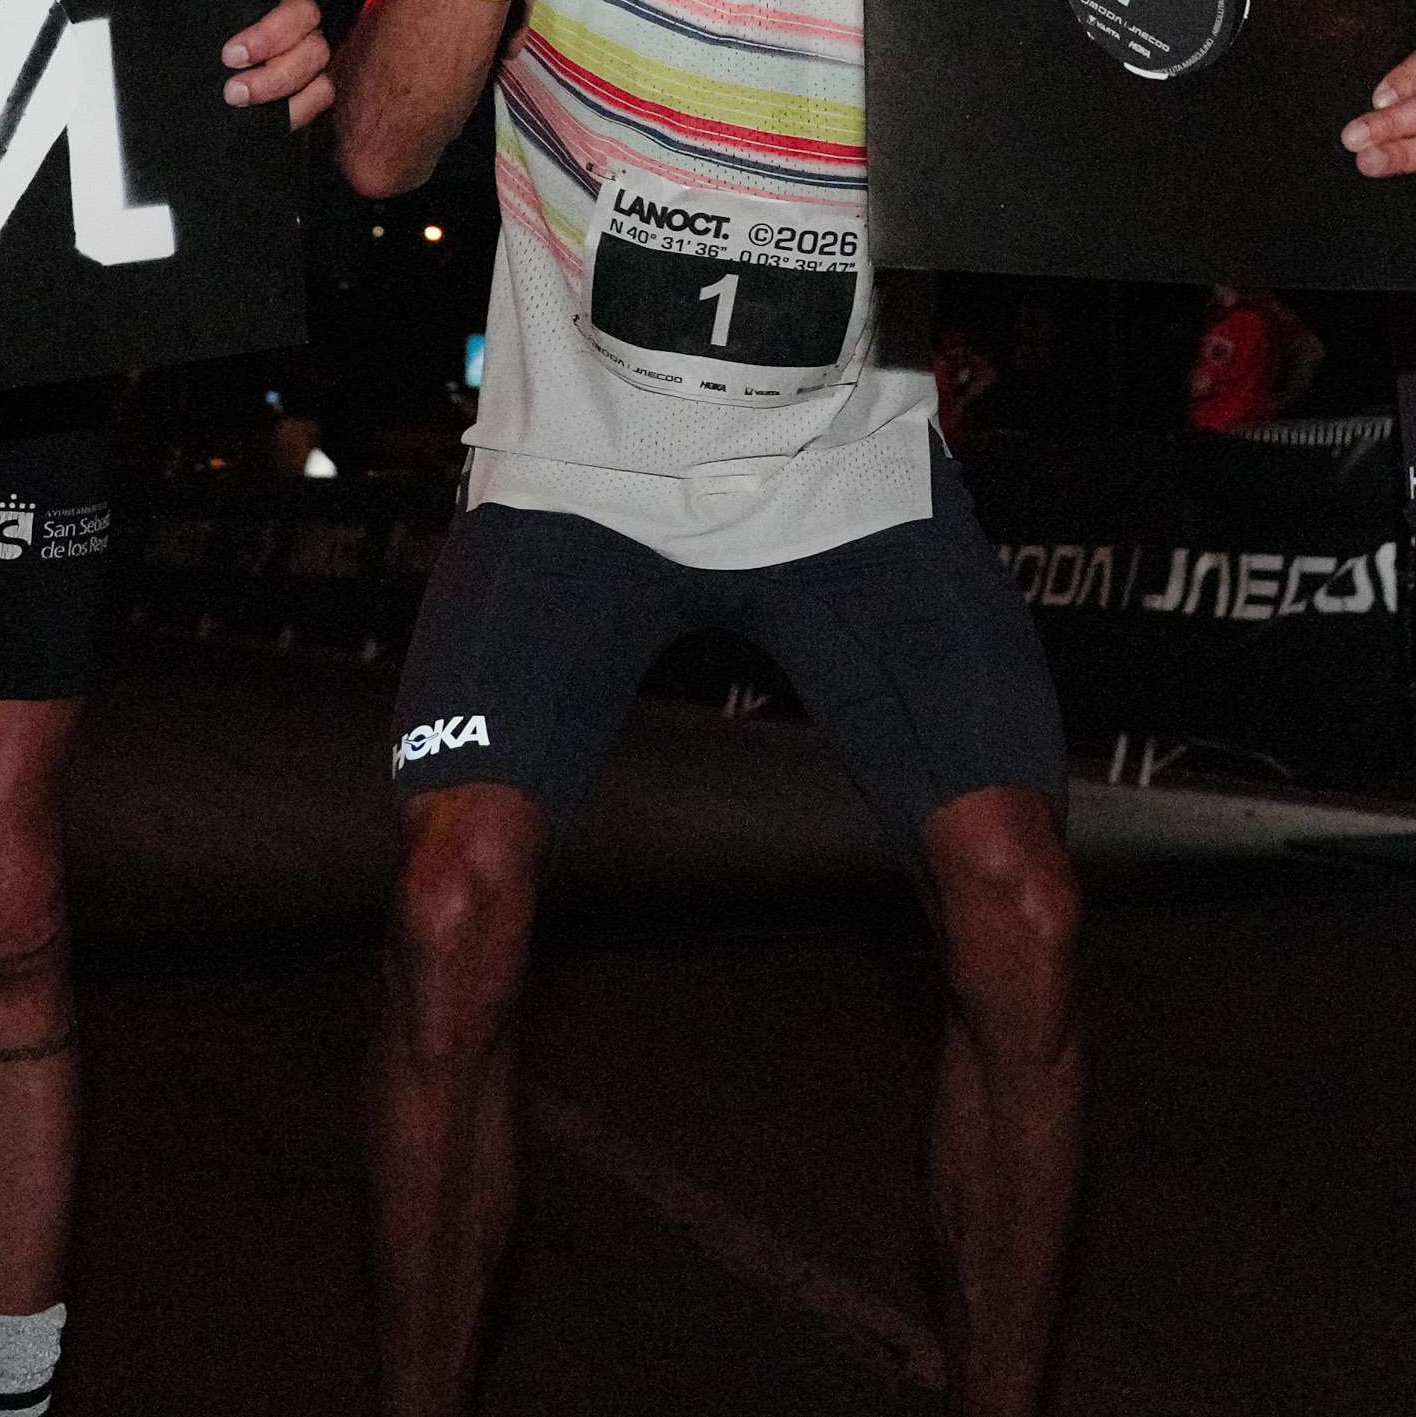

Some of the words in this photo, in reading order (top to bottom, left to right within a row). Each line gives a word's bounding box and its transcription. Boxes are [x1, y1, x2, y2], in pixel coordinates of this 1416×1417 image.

[609, 218, 624, 234] N
[626, 226, 658, 244] 40°
[613, 188, 731, 240] LANOCT.
[699, 273, 740, 347] 1
[43, 520, 76, 538] San
[41, 540, 65, 559] de
[67, 539, 88, 557] los
[392, 715, 491, 780] HOKA
